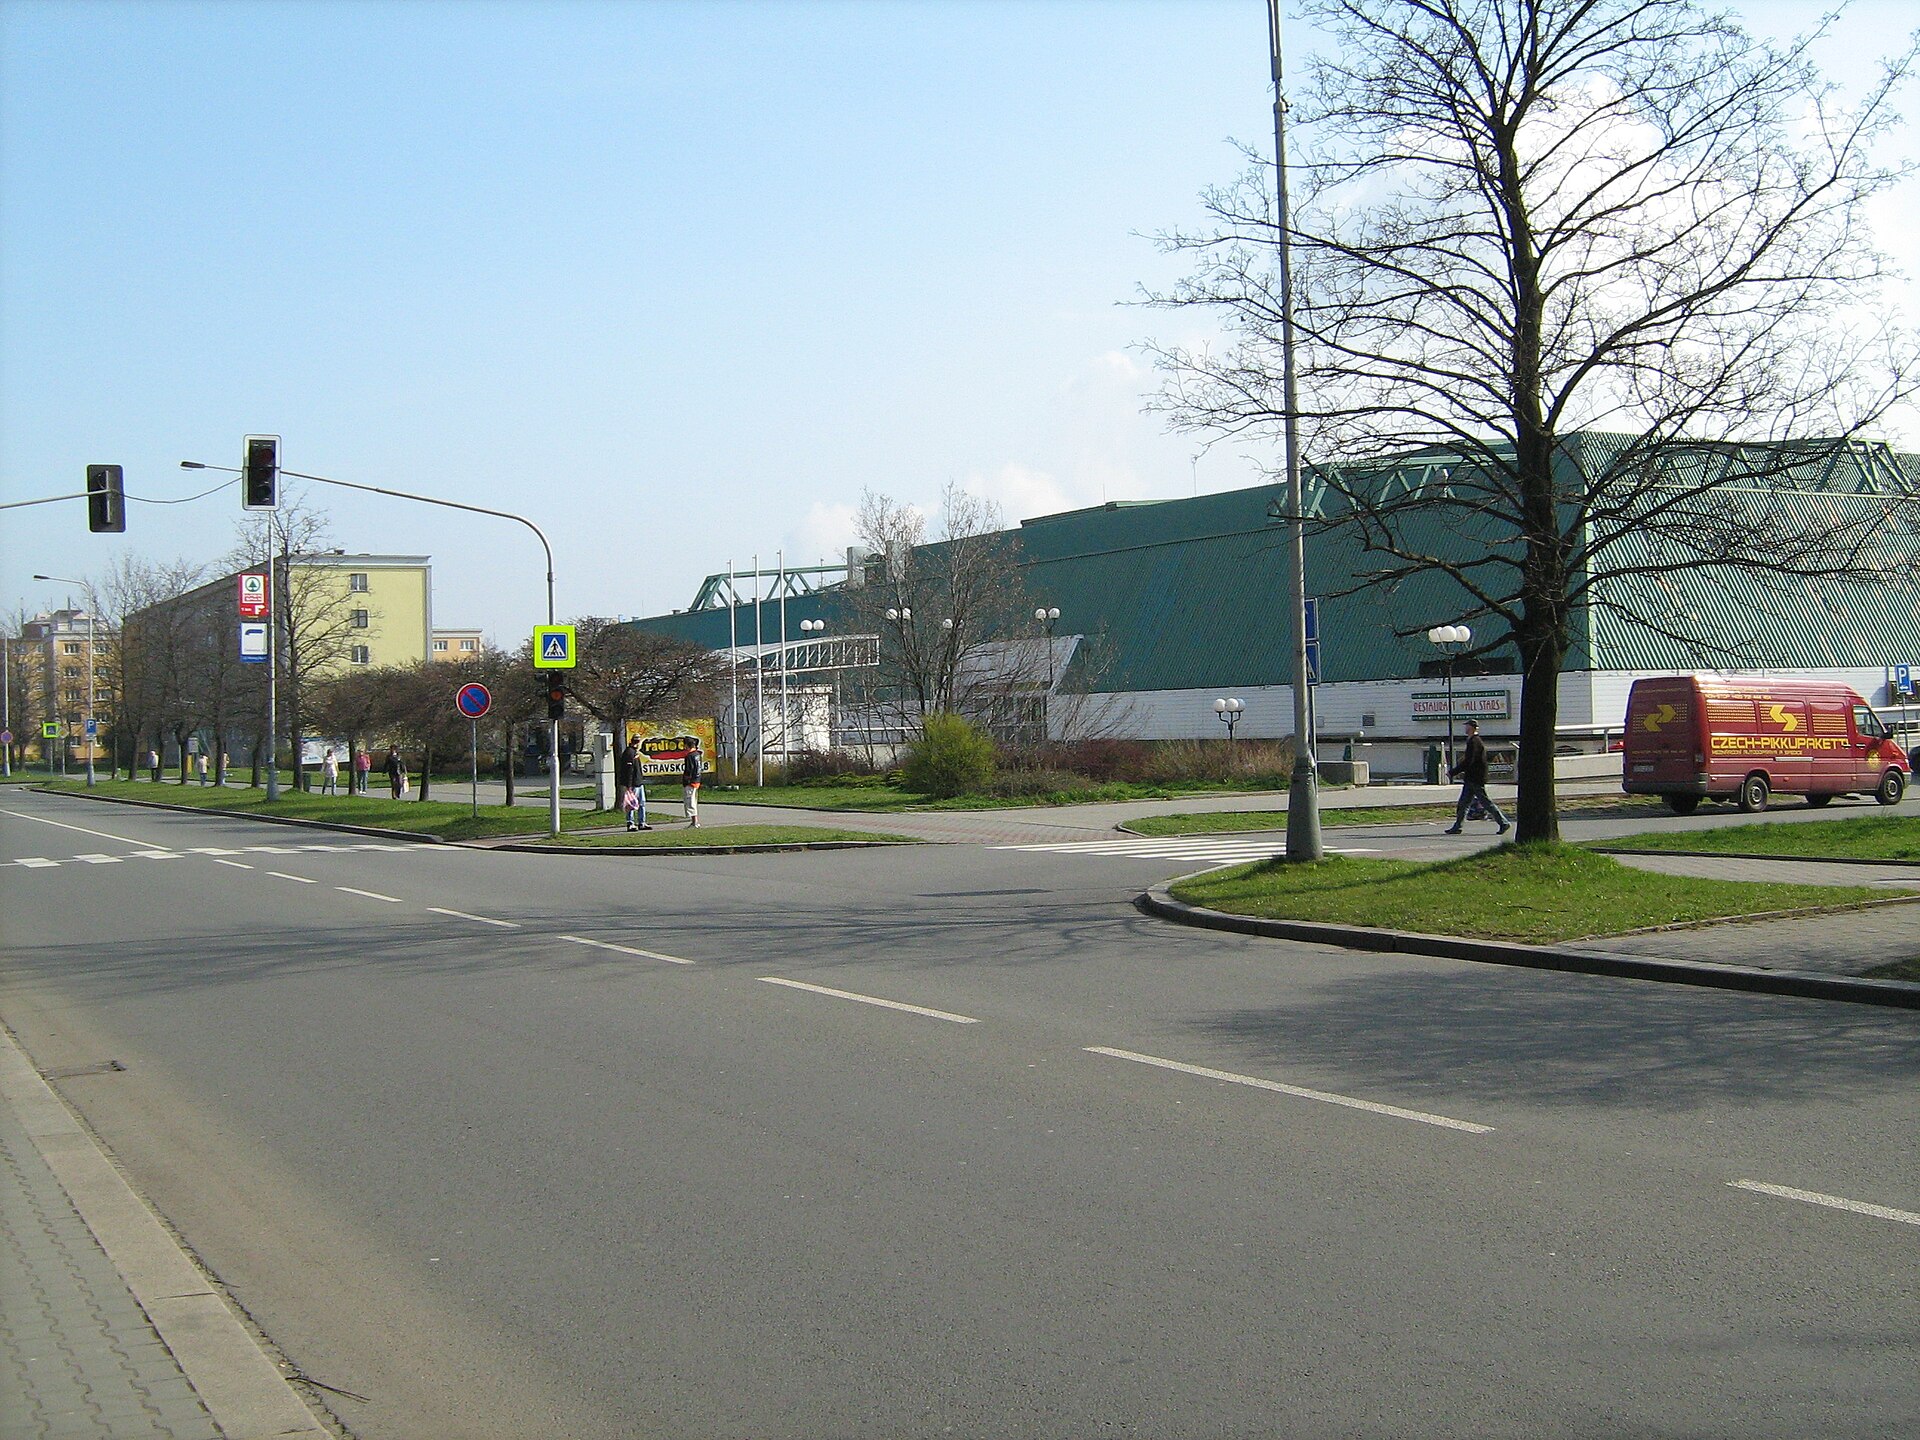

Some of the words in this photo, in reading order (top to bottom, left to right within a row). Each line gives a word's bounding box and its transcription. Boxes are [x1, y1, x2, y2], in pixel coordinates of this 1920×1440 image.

[1898, 667, 1907, 684] P
[1413, 701, 1456, 712] RESTAURAT
[1465, 700, 1478, 711] ALL
[1479, 699, 1500, 711] STARS
[87, 720, 95, 729] P
[645, 740, 676, 751] radio
